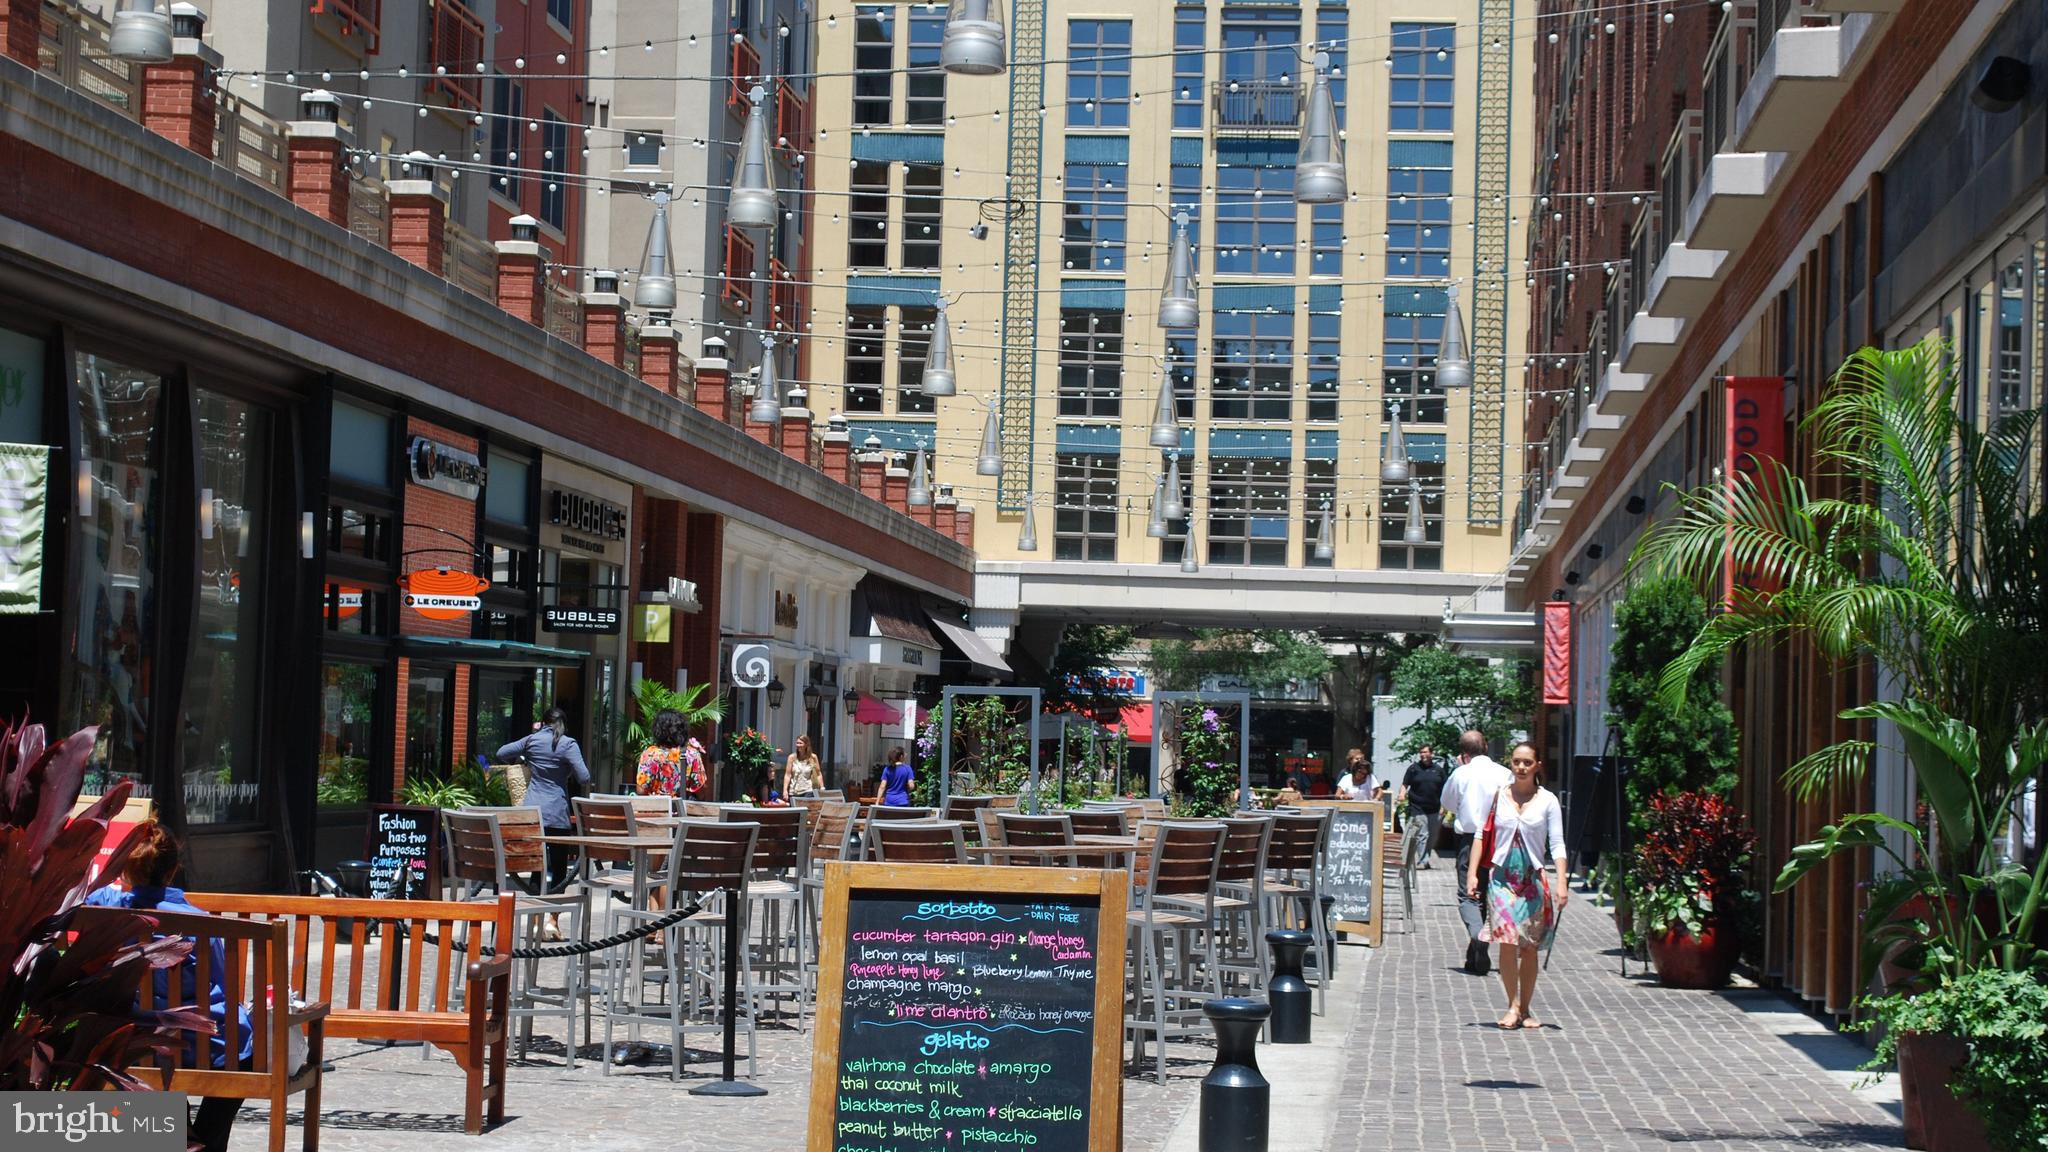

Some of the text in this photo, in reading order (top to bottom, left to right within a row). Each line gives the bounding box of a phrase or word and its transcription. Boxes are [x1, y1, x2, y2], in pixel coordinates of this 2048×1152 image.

[431, 599, 479, 608] CREUSET
[546, 610, 616, 623] BUBBLES
[379, 813, 417, 832] Fashion
[1332, 823, 1368, 835] come
[388, 830, 427, 844] has two
[1329, 833, 1370, 850] edwood
[1031, 911, 1080, 923] DAIRY FREE
[852, 928, 916, 943] cucumber
[990, 930, 1015, 950] gin
[1057, 930, 1085, 950] honey
[861, 945, 964, 967] lemon opal basil
[972, 964, 1023, 980] Blueberry
[847, 977, 972, 1000] champagne mango
[895, 1003, 925, 1018] lime
[919, 1030, 990, 1056] gelato
[845, 1057, 1052, 1084] valrhona chocolate amargo
[841, 1076, 963, 1098] thai coconut milk
[839, 1095, 1083, 1121] blackberries & cream stracciatella
[838, 1120, 1038, 1146] peanut butter pistacchio
